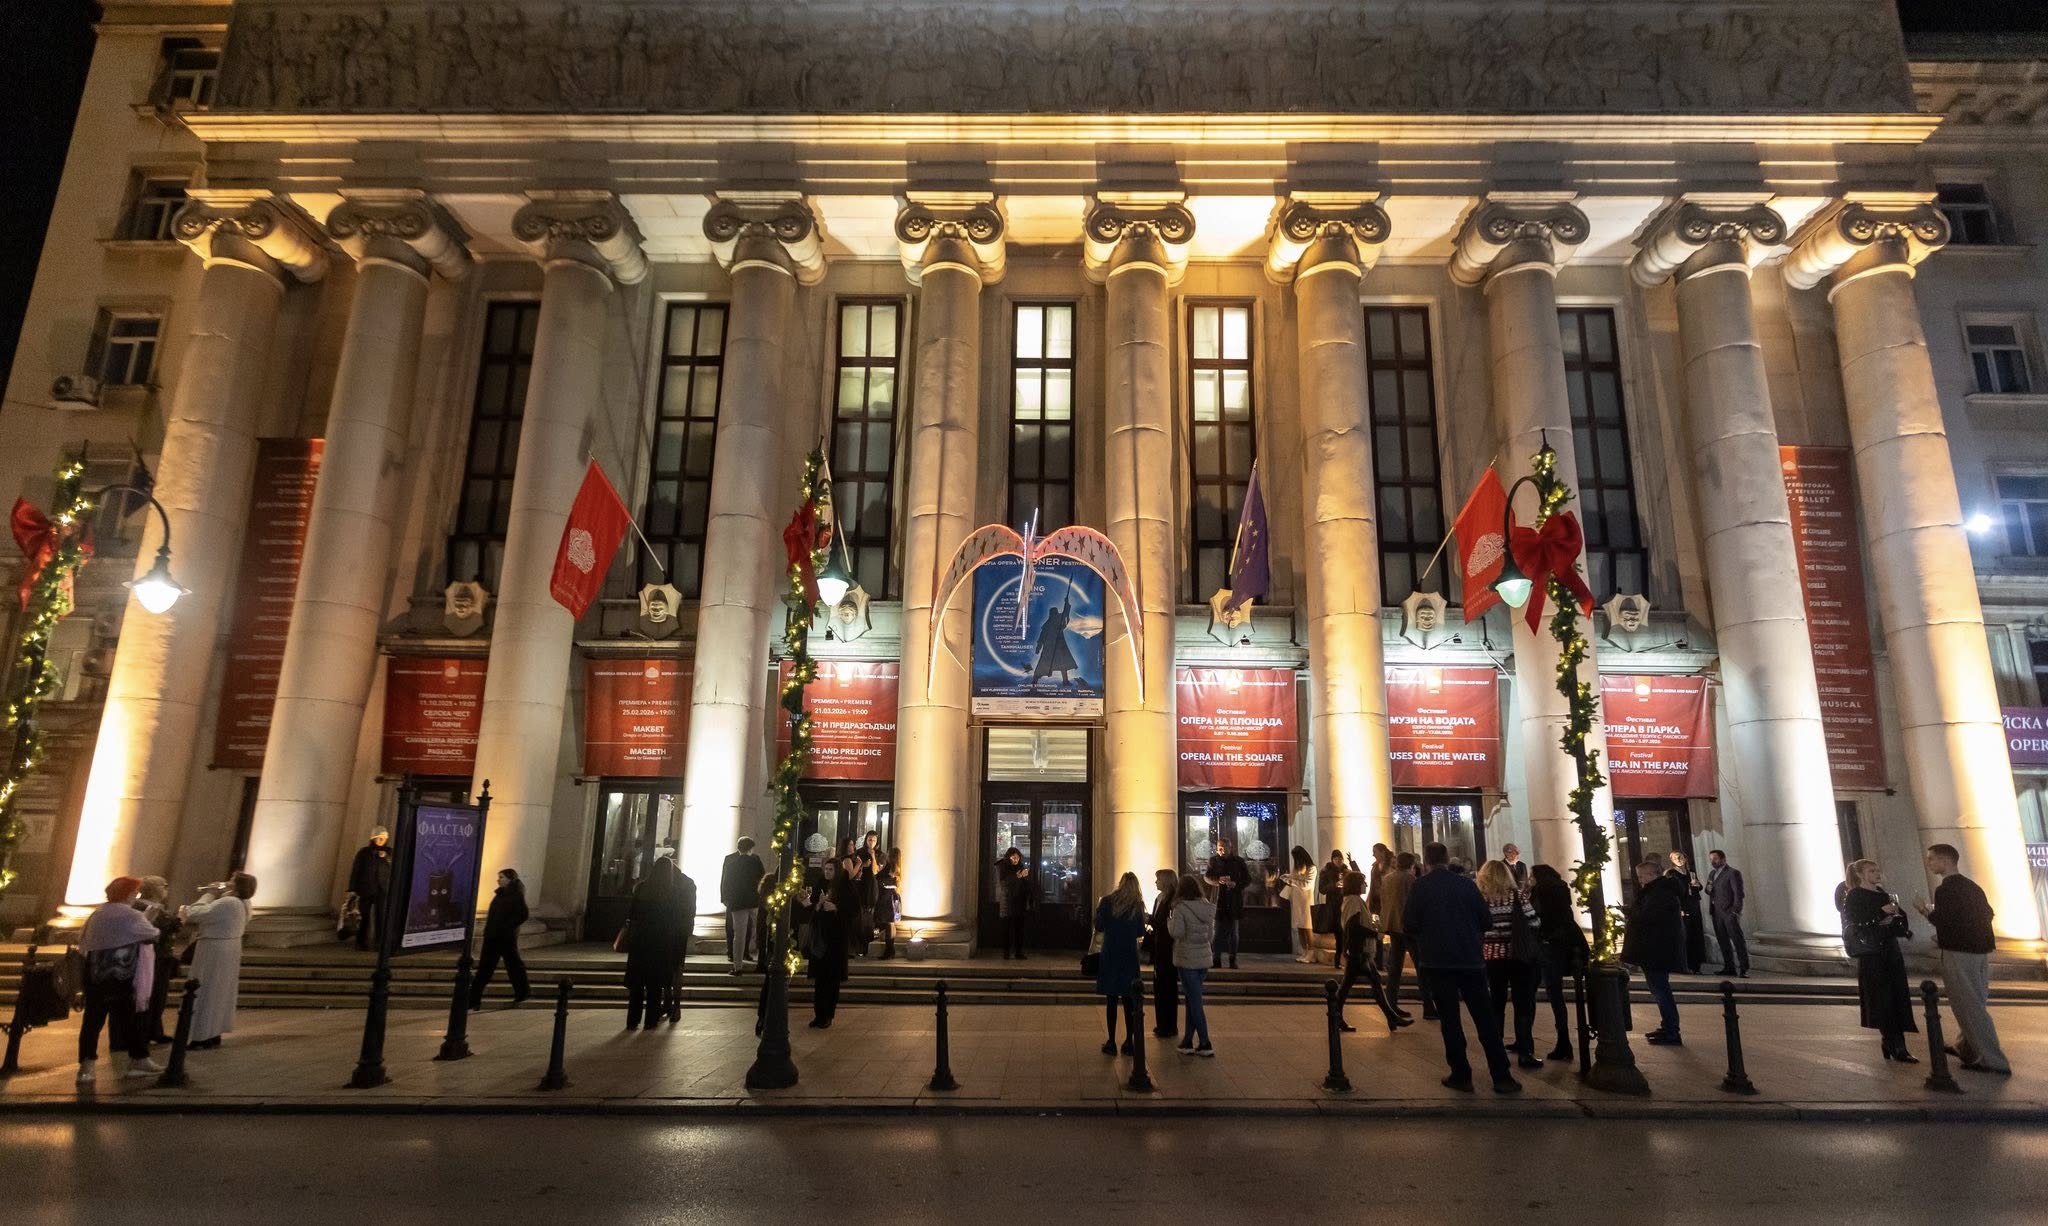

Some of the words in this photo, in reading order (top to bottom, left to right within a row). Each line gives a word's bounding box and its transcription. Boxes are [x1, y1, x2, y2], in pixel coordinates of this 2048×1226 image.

[1181, 717, 1212, 725] ОПЕРА
[1215, 717, 1229, 725] НА
[1230, 717, 1283, 726] ПЛОЩАДА
[1390, 717, 1418, 725] МУЗИ
[1419, 717, 1434, 725] НА
[1436, 717, 1476, 726] ВОДАТА
[830, 722, 896, 731] ПРЕДРАЗСЪДЪЦИ
[1604, 725, 1636, 733] ОПЕРА
[1638, 725, 1644, 733] В
[1647, 726, 1680, 734] ПАРКА
[840, 748, 881, 756] PREJUDICE
[1415, 752, 1431, 760] ON
[1452, 753, 1486, 761] WATER
[1225, 753, 1243, 761] THE
[1609, 760, 1628, 768] ERA
[1642, 761, 1661, 769] THE
[1663, 761, 1688, 769] PARK
